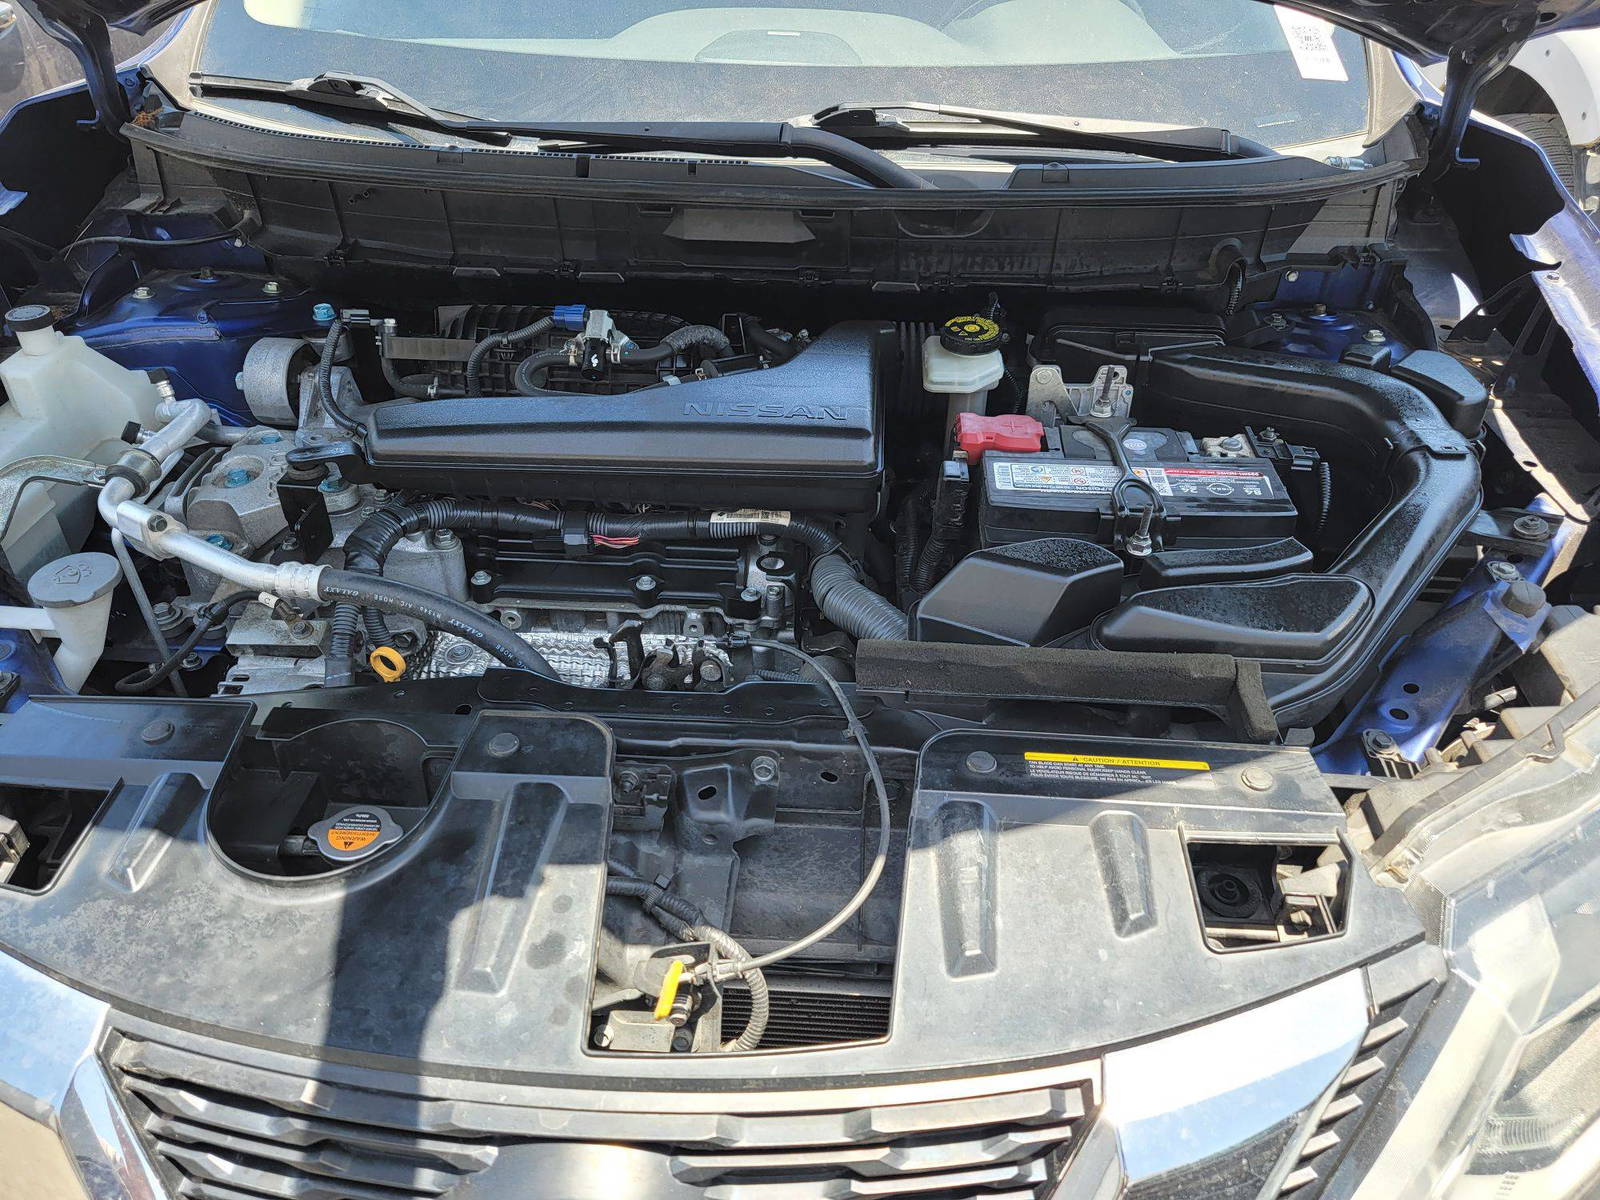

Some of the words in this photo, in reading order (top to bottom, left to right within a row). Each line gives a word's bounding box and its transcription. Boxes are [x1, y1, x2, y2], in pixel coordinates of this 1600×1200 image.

[683, 402, 848, 420] NISSAN
[324, 586, 359, 596] GALAXY
[374, 594, 393, 603] HOSE
[448, 618, 484, 638] GALAXY
[495, 643, 514, 659] HOSE
